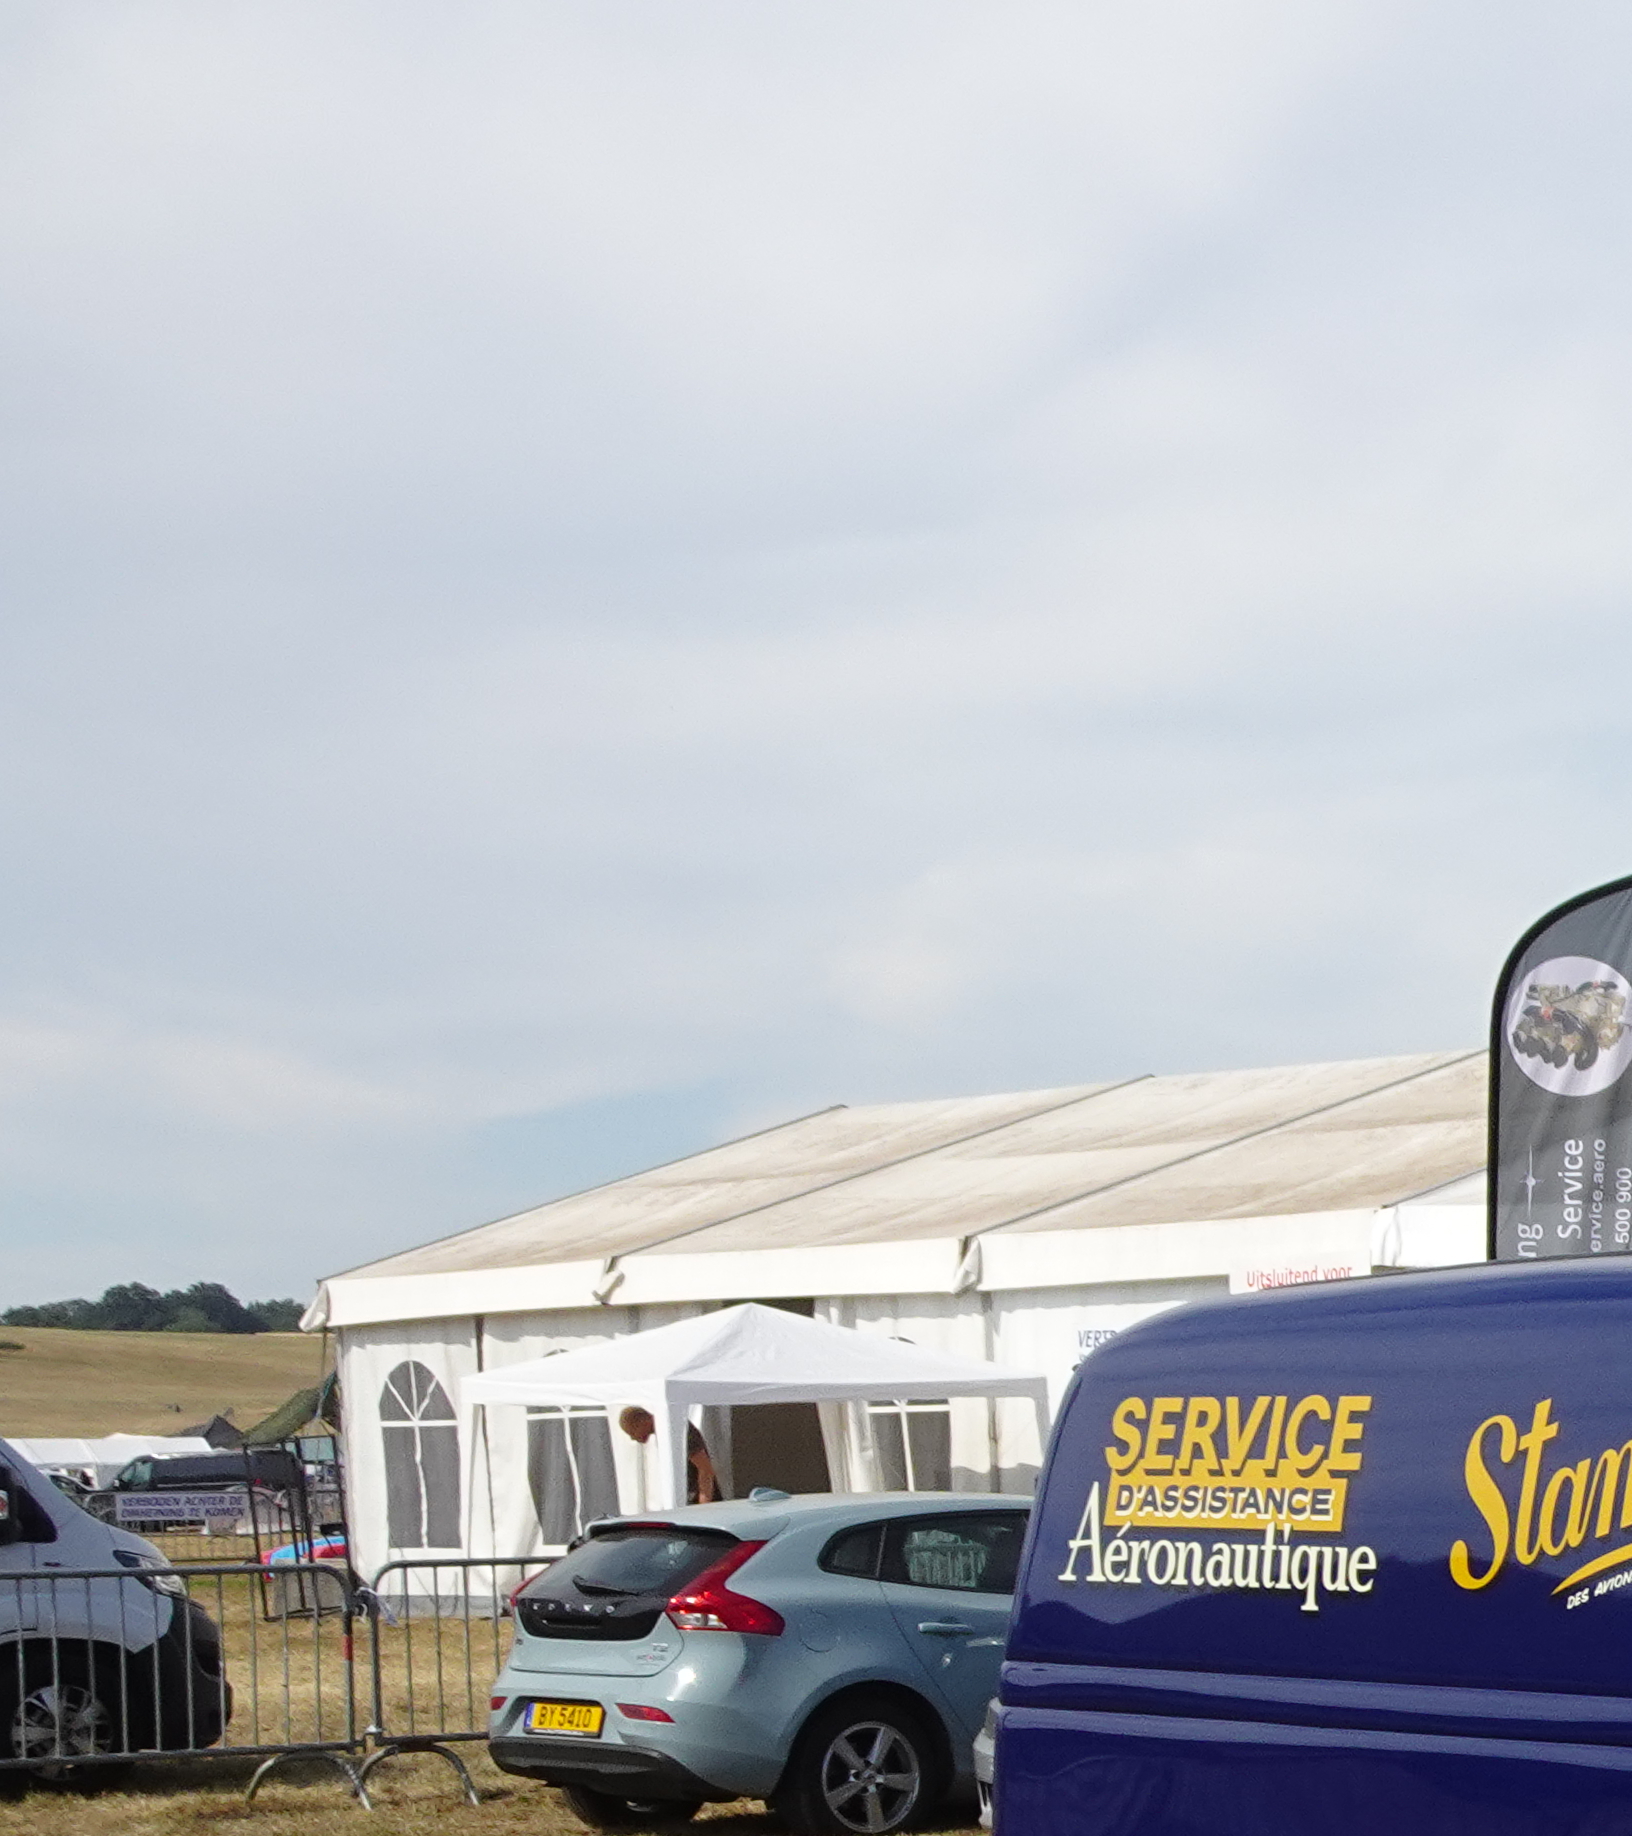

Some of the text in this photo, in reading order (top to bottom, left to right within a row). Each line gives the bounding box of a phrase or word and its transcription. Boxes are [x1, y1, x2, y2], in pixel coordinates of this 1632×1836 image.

[1557, 1138, 1584, 1240] Service
[1614, 1167, 1632, 1244] 500 900
[1246, 1265, 1353, 1290] Uitsluitend voor
[1103, 1395, 1372, 1475] SERVICE
[184, 1495, 226, 1506] ACHTER
[229, 1496, 244, 1506] DE
[204, 1507, 245, 1517] KOMEN
[1114, 1485, 1336, 1523] D'ASSISTANCE
[1058, 1481, 1378, 1612] Aéronautique
[1566, 1588, 1590, 1610] DES
[538, 1705, 593, 1729] BY 5410
